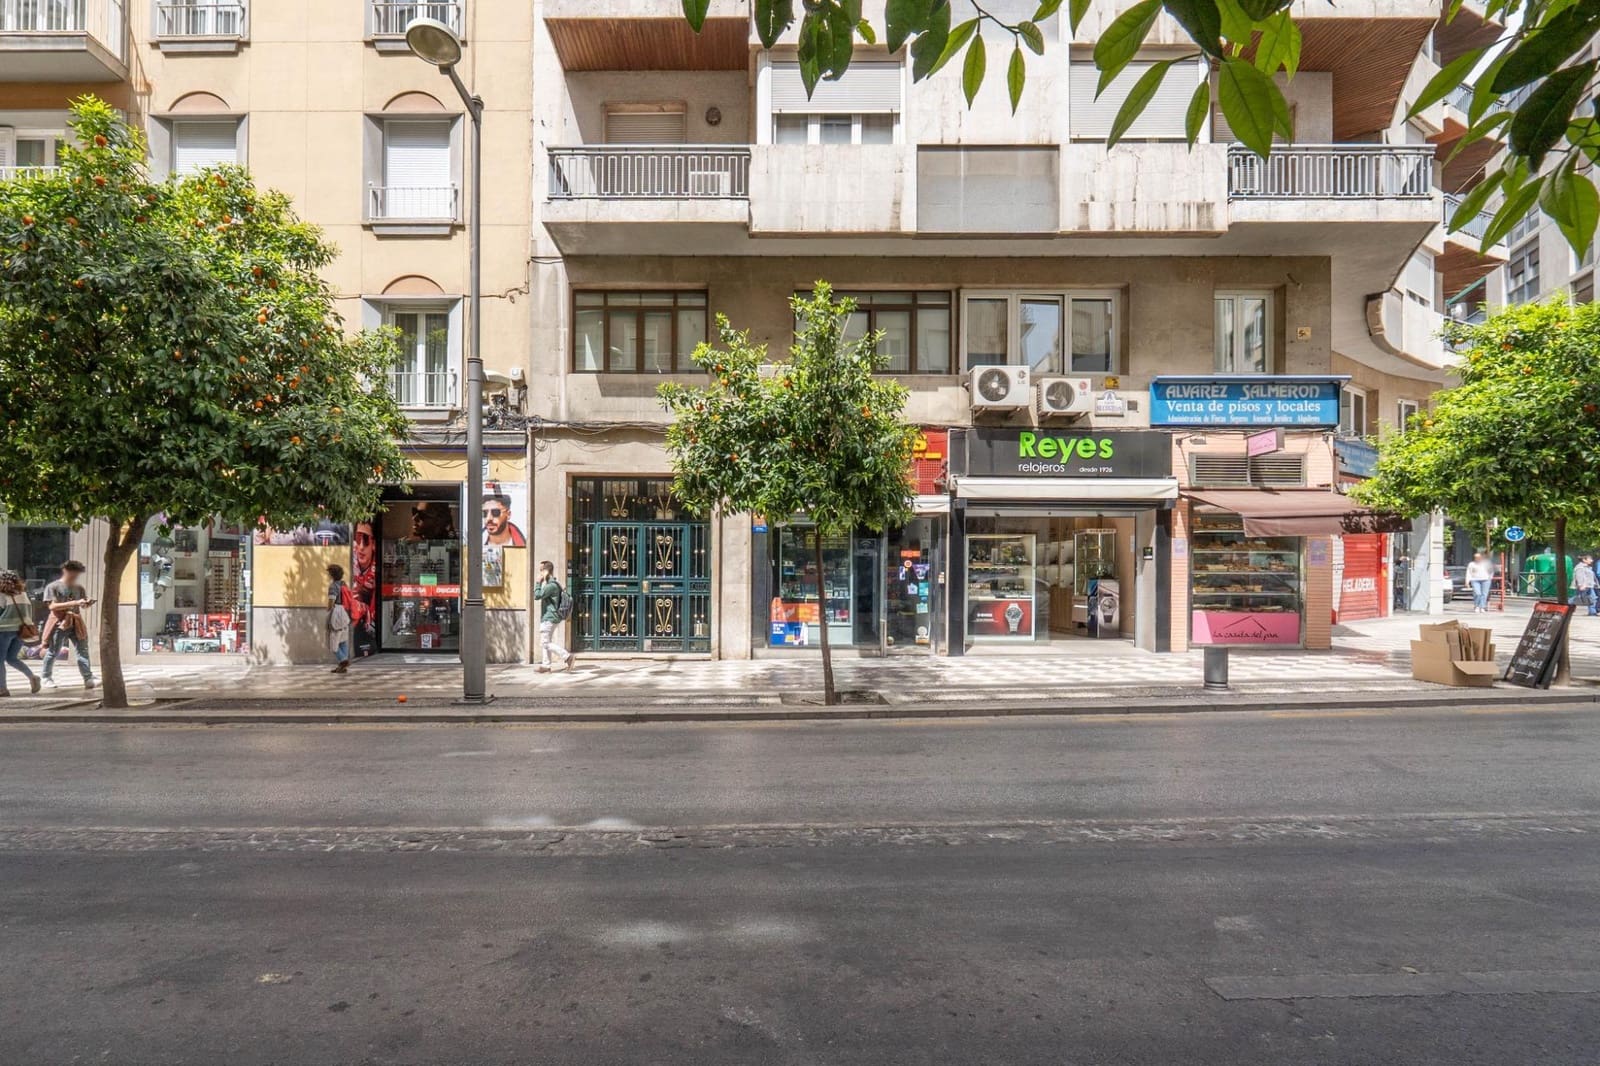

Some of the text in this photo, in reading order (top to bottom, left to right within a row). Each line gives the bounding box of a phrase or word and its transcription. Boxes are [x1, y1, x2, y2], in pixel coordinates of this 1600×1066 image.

[1166, 385, 1320, 400] ALVAREZ SALMERON
[1166, 401, 1321, 414] Venta de pisos y locales
[1019, 432, 1113, 464] Reyes
[1018, 462, 1065, 474] relojeros
